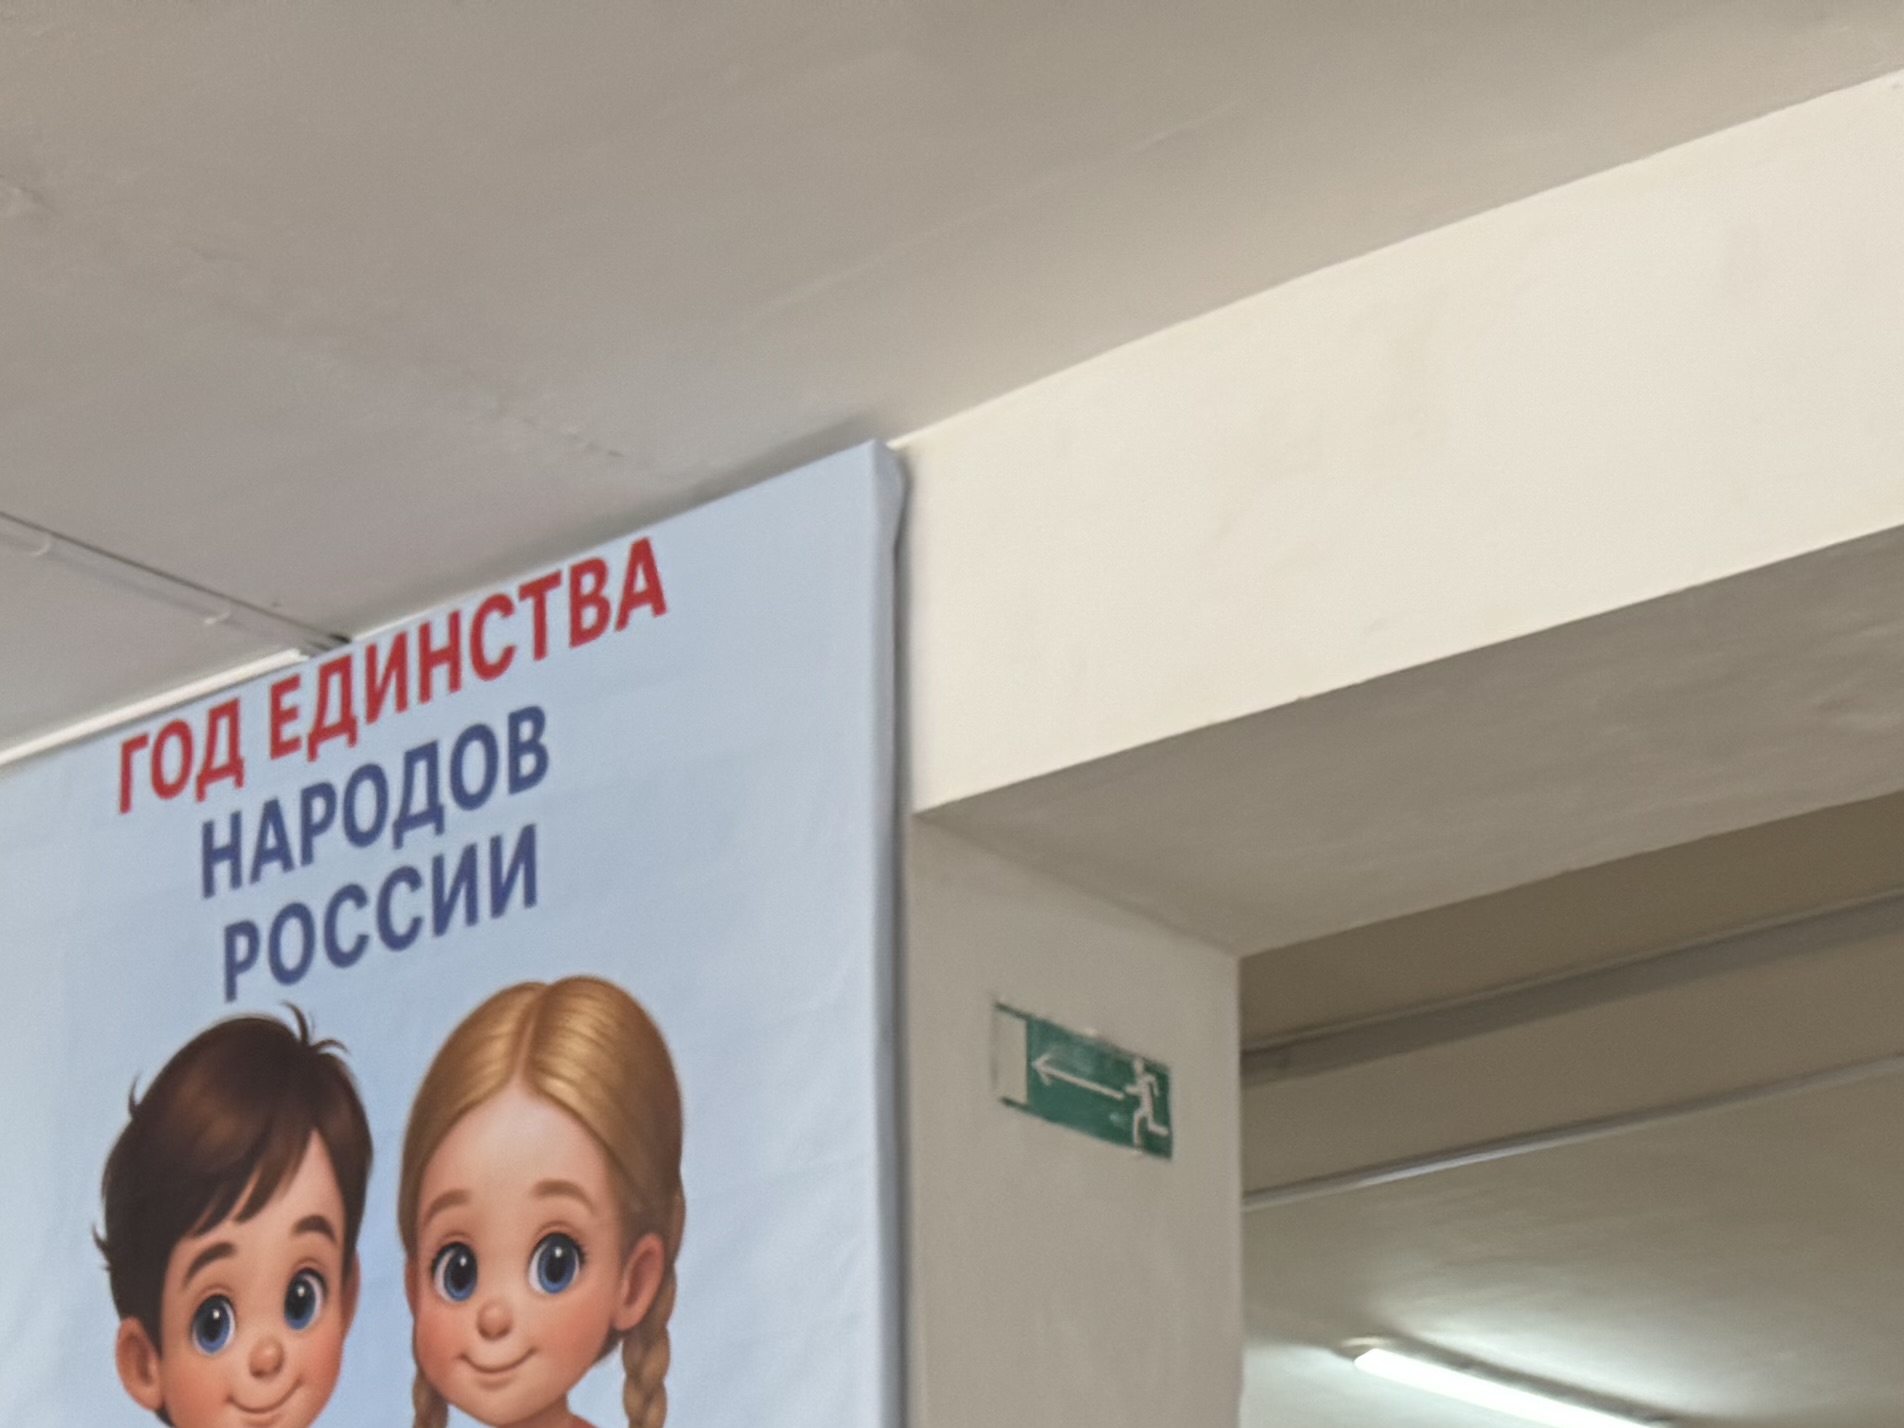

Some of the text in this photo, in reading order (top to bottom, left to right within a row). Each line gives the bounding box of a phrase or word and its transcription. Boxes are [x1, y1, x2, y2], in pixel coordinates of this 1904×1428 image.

[119, 537, 668, 815] ГОД ЕДИНСТВА
[201, 705, 550, 900] НАРОДОВ
[223, 823, 539, 1003] РОССИИ
